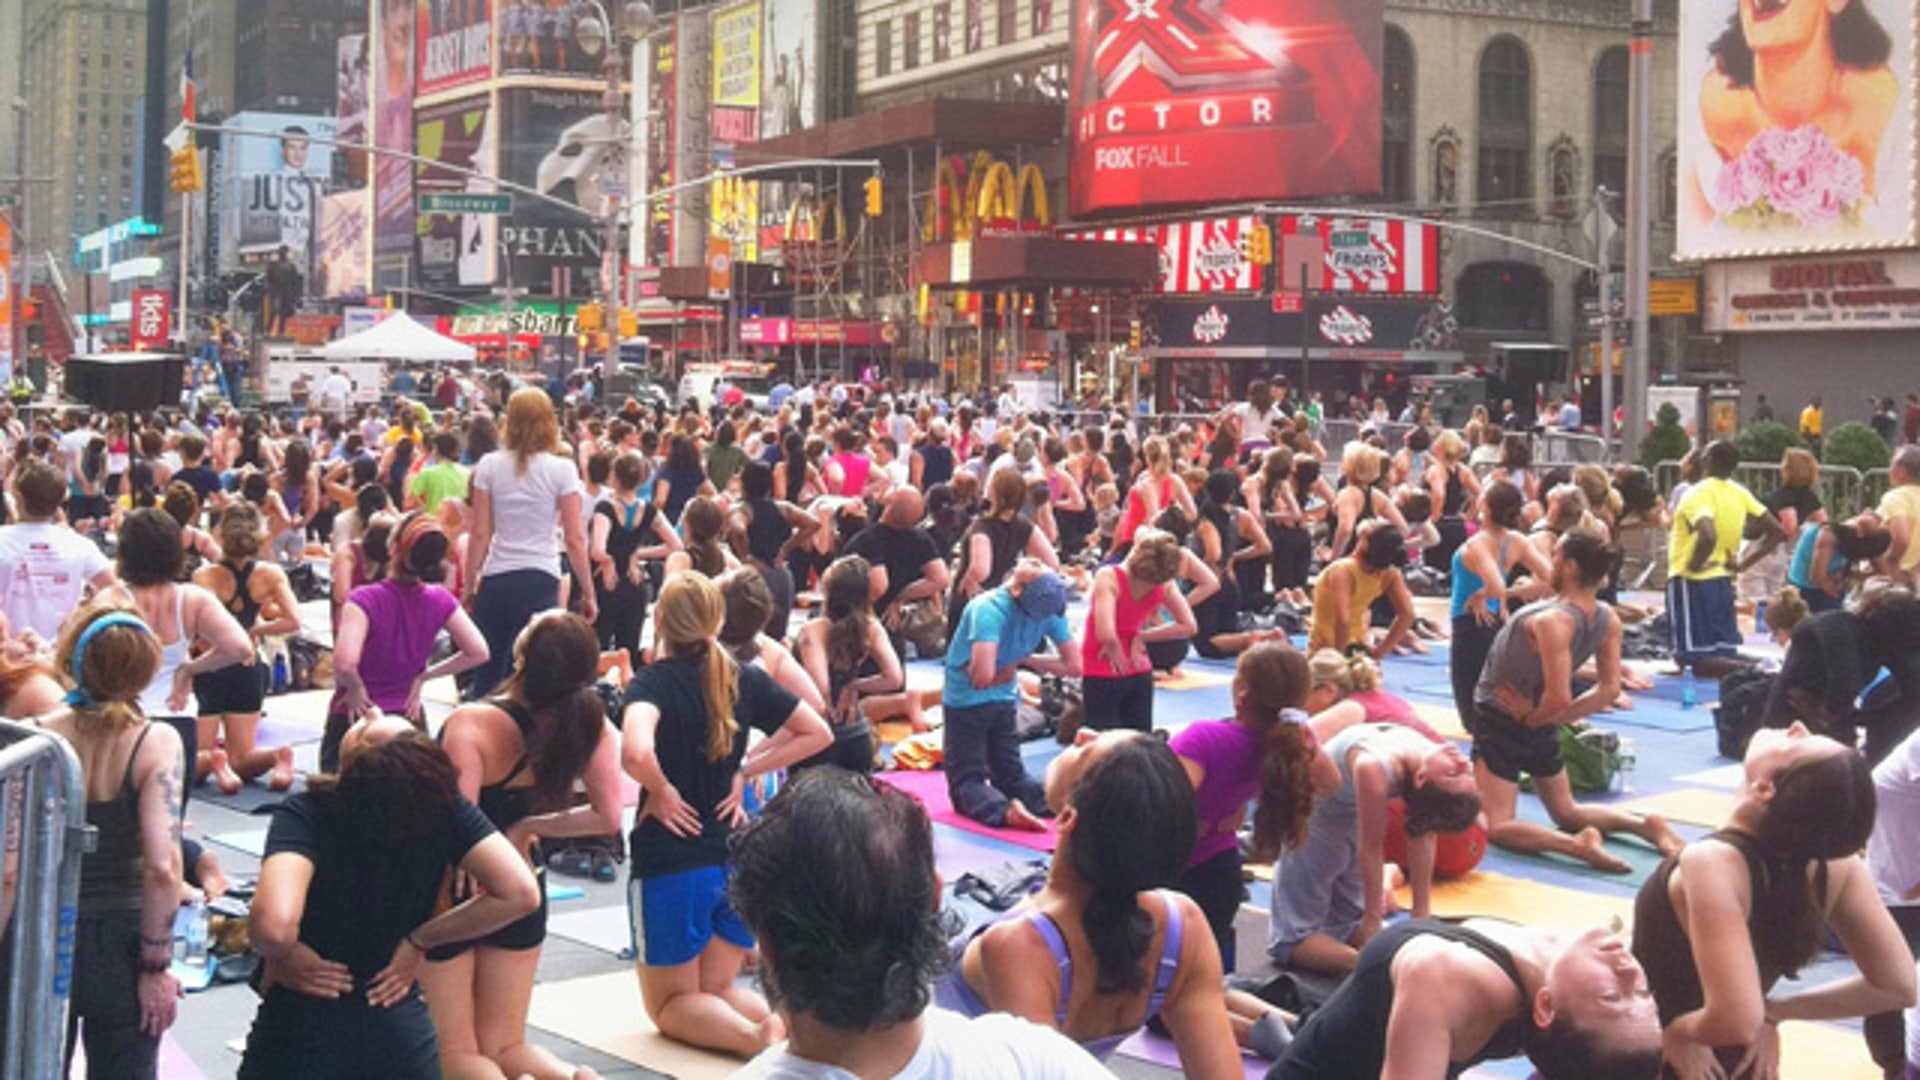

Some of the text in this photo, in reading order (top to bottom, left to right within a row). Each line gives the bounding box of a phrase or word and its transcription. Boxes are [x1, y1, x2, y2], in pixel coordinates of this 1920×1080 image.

[1095, 144, 1189, 171] FOX FALL
[248, 173, 327, 213] JUST
[430, 196, 498, 211] Broadway
[503, 227, 604, 256] PHAN
